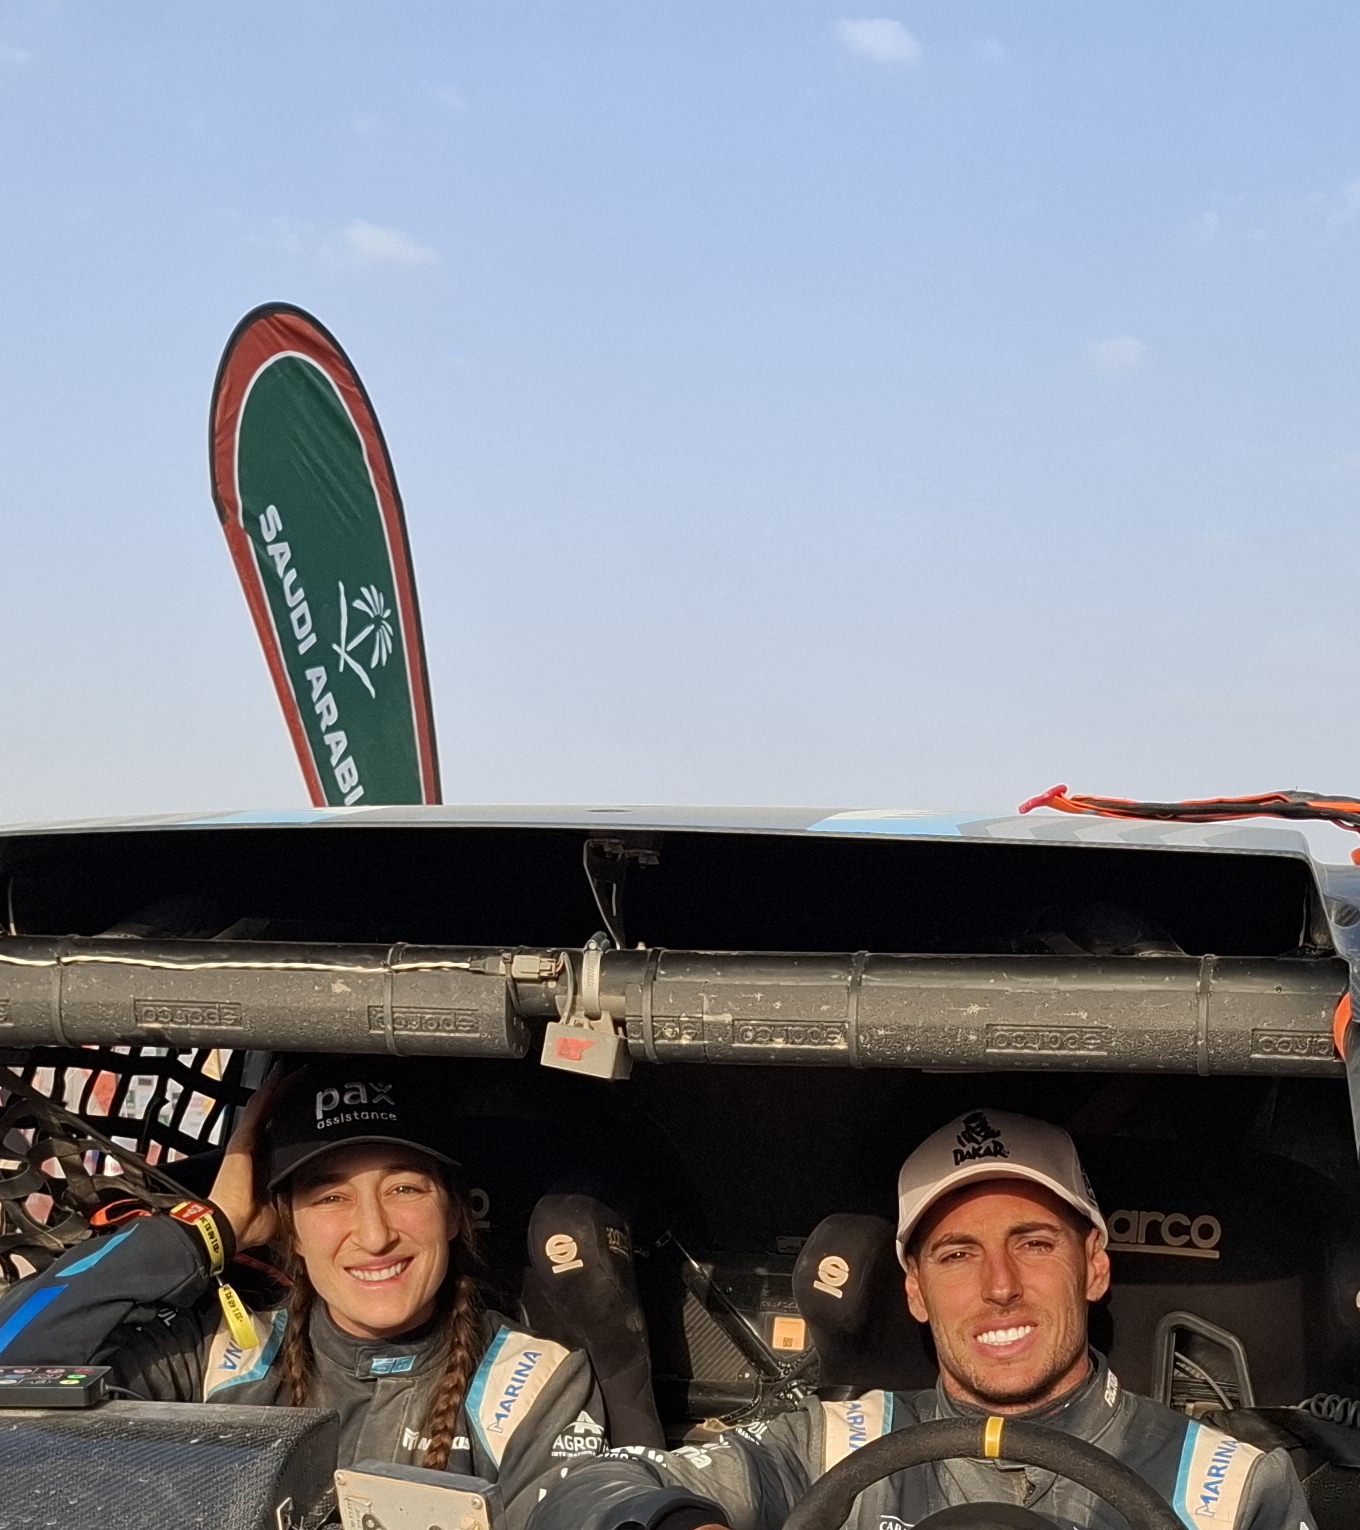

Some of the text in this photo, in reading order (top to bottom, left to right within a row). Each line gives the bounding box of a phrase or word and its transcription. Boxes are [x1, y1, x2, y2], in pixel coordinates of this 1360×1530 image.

[259, 504, 317, 655] SAUDI
[316, 1081, 395, 1120] pax
[317, 1110, 397, 1129] assistance
[953, 1144, 1009, 1165] DAKAR
[488, 1350, 542, 1433] MARINA
[1195, 1439, 1238, 1518] MARINA
